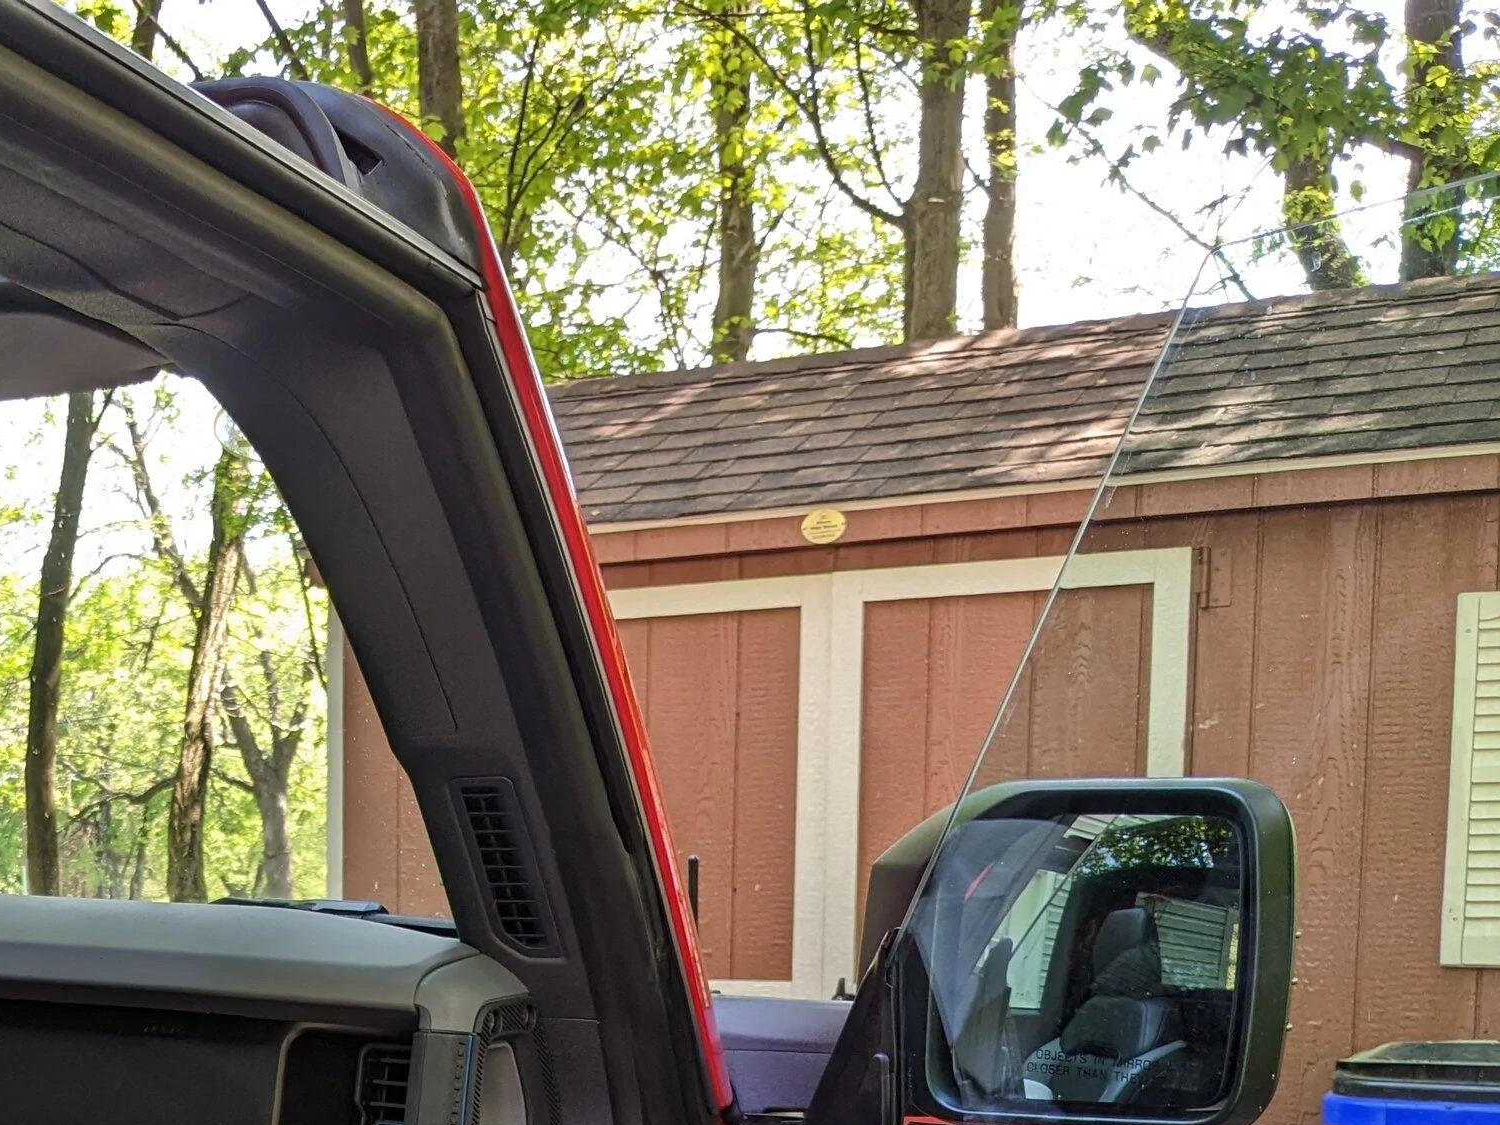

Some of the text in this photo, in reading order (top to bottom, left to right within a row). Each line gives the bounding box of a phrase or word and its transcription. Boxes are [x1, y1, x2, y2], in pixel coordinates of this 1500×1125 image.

[1036, 1049, 1087, 1064] OBJECTS
[1094, 1057, 1105, 1066] IN
[1026, 1061, 1146, 1085] CLOSER THAN THE
